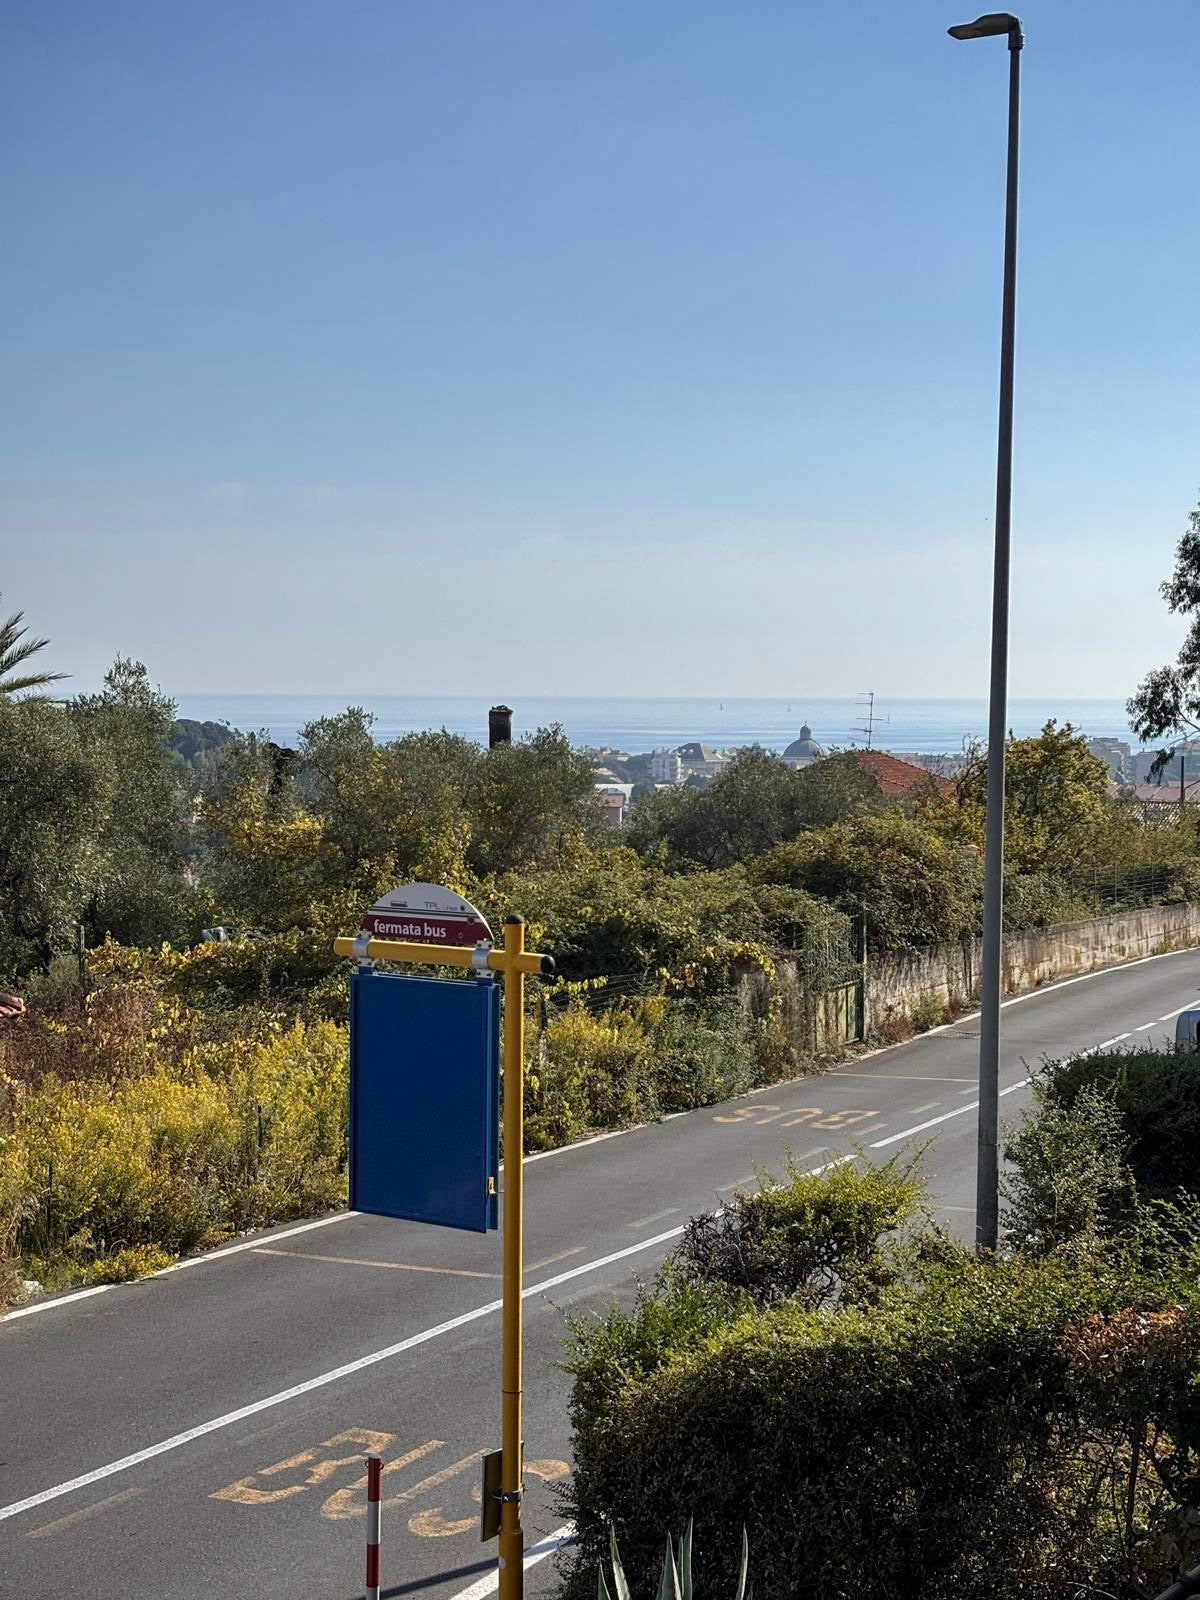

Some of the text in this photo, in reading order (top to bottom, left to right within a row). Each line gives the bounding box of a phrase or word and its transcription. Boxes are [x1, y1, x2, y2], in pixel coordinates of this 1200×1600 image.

[373, 918, 447, 938] fermata bus
[711, 1104, 881, 1130] BUS
[208, 1427, 571, 1537] BUS
